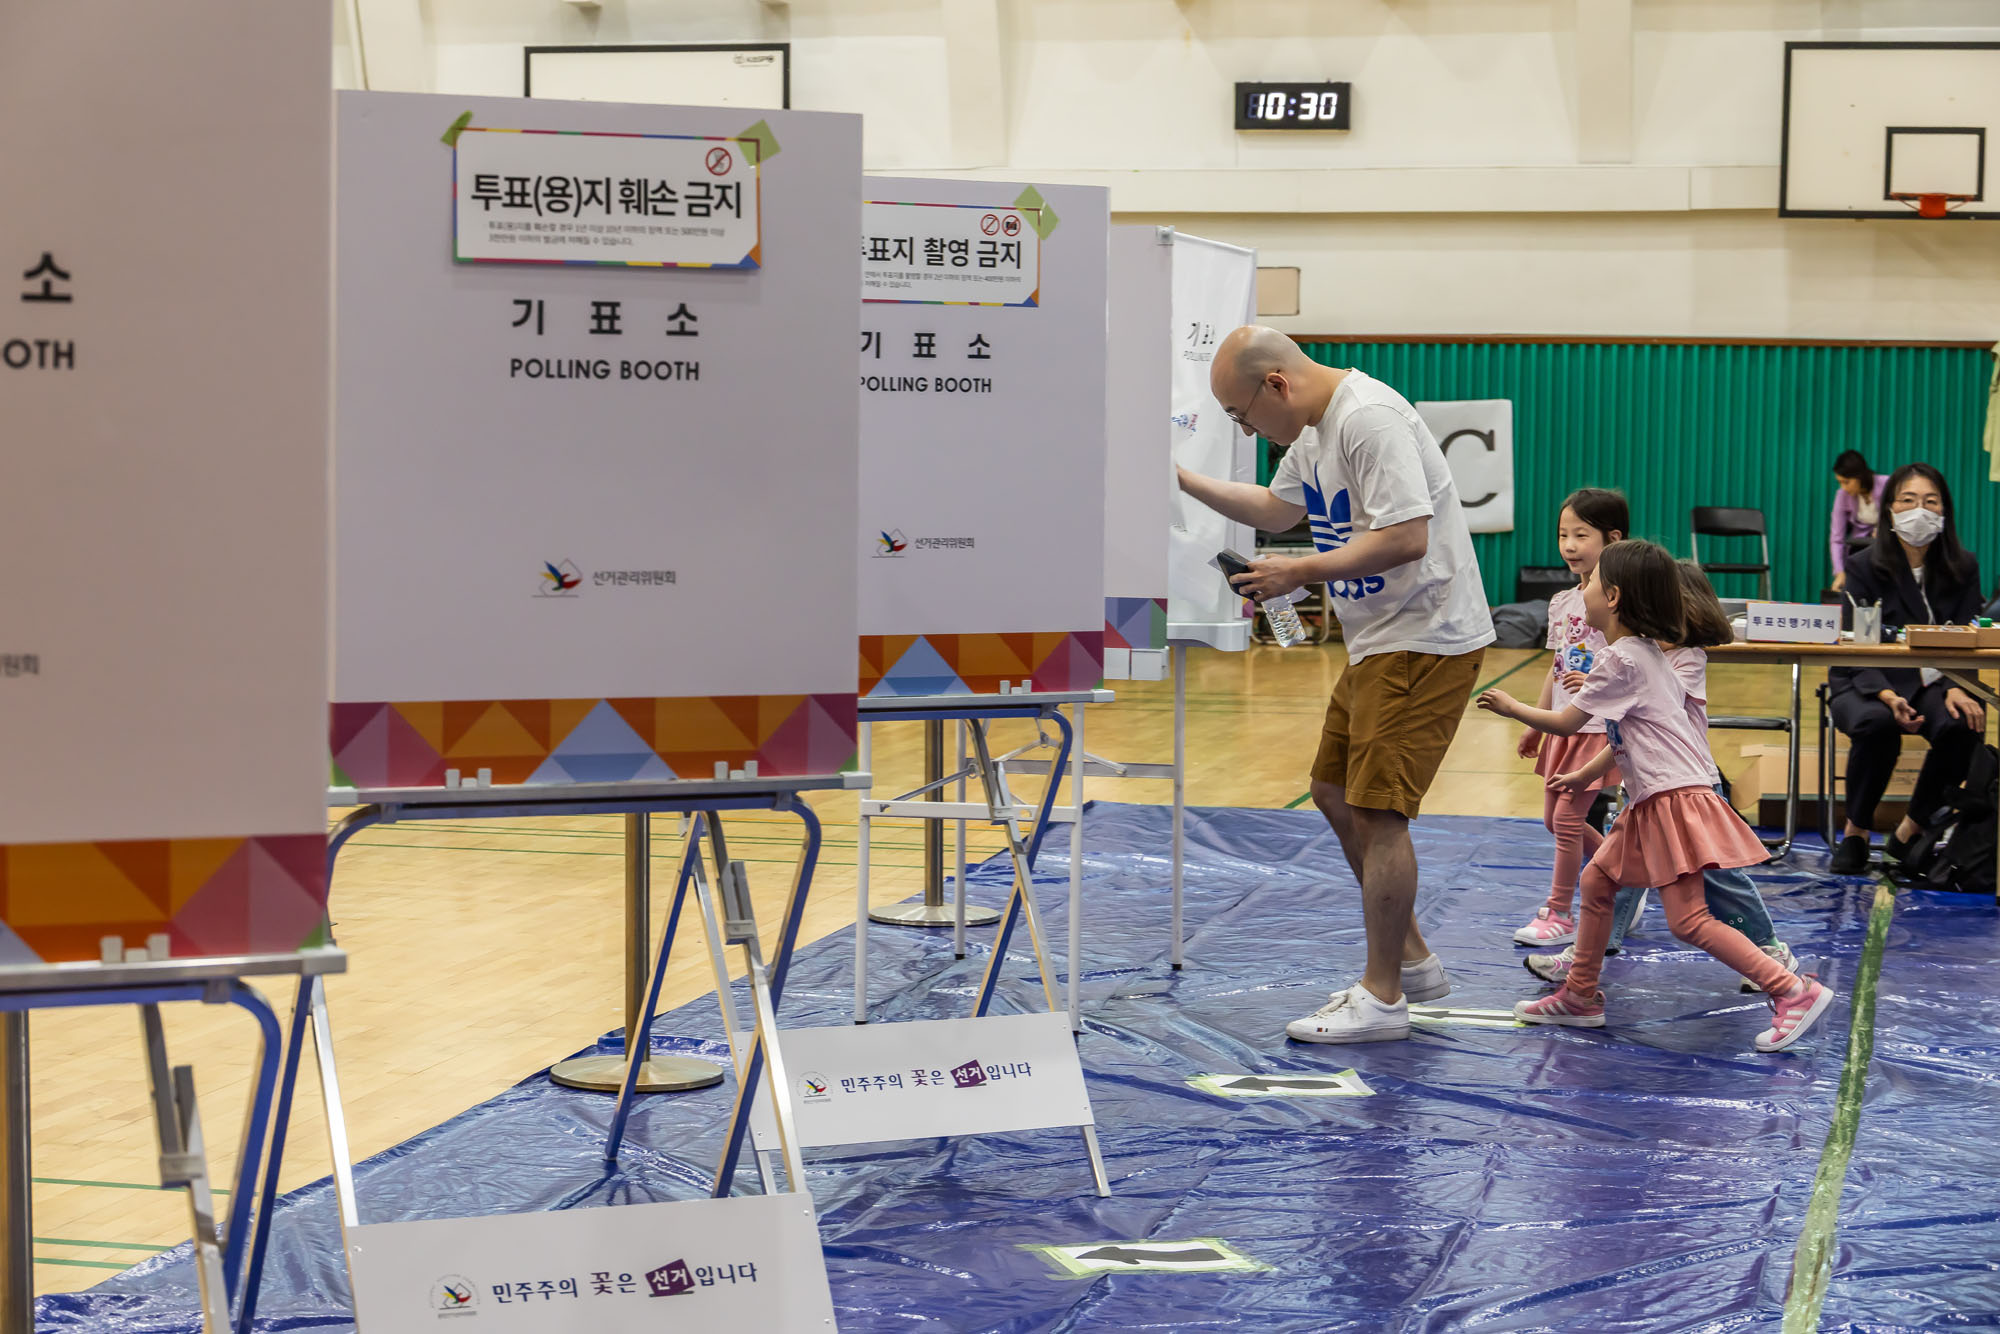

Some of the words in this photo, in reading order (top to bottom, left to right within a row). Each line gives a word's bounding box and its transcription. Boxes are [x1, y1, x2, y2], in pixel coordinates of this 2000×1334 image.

[1257, 92, 1338, 120] 10:30
[471, 174, 611, 217] 투표(용)지
[618, 178, 679, 217] 훼손
[684, 181, 741, 219] 금지
[862, 236, 914, 266] 표지
[923, 237, 969, 268] 촬영
[976, 240, 1021, 270] 금지
[0, 338, 75, 370] OTH
[510, 358, 611, 380] POLLING
[620, 360, 700, 381] BOOTH
[934, 377, 992, 393] BOOTH
[592, 570, 677, 586] 선거관리위원회
[840, 1073, 904, 1094] 민주주의
[911, 1069, 945, 1087] 꽃은
[492, 1277, 578, 1304] 민주주의
[590, 1271, 637, 1296] 꽃은
